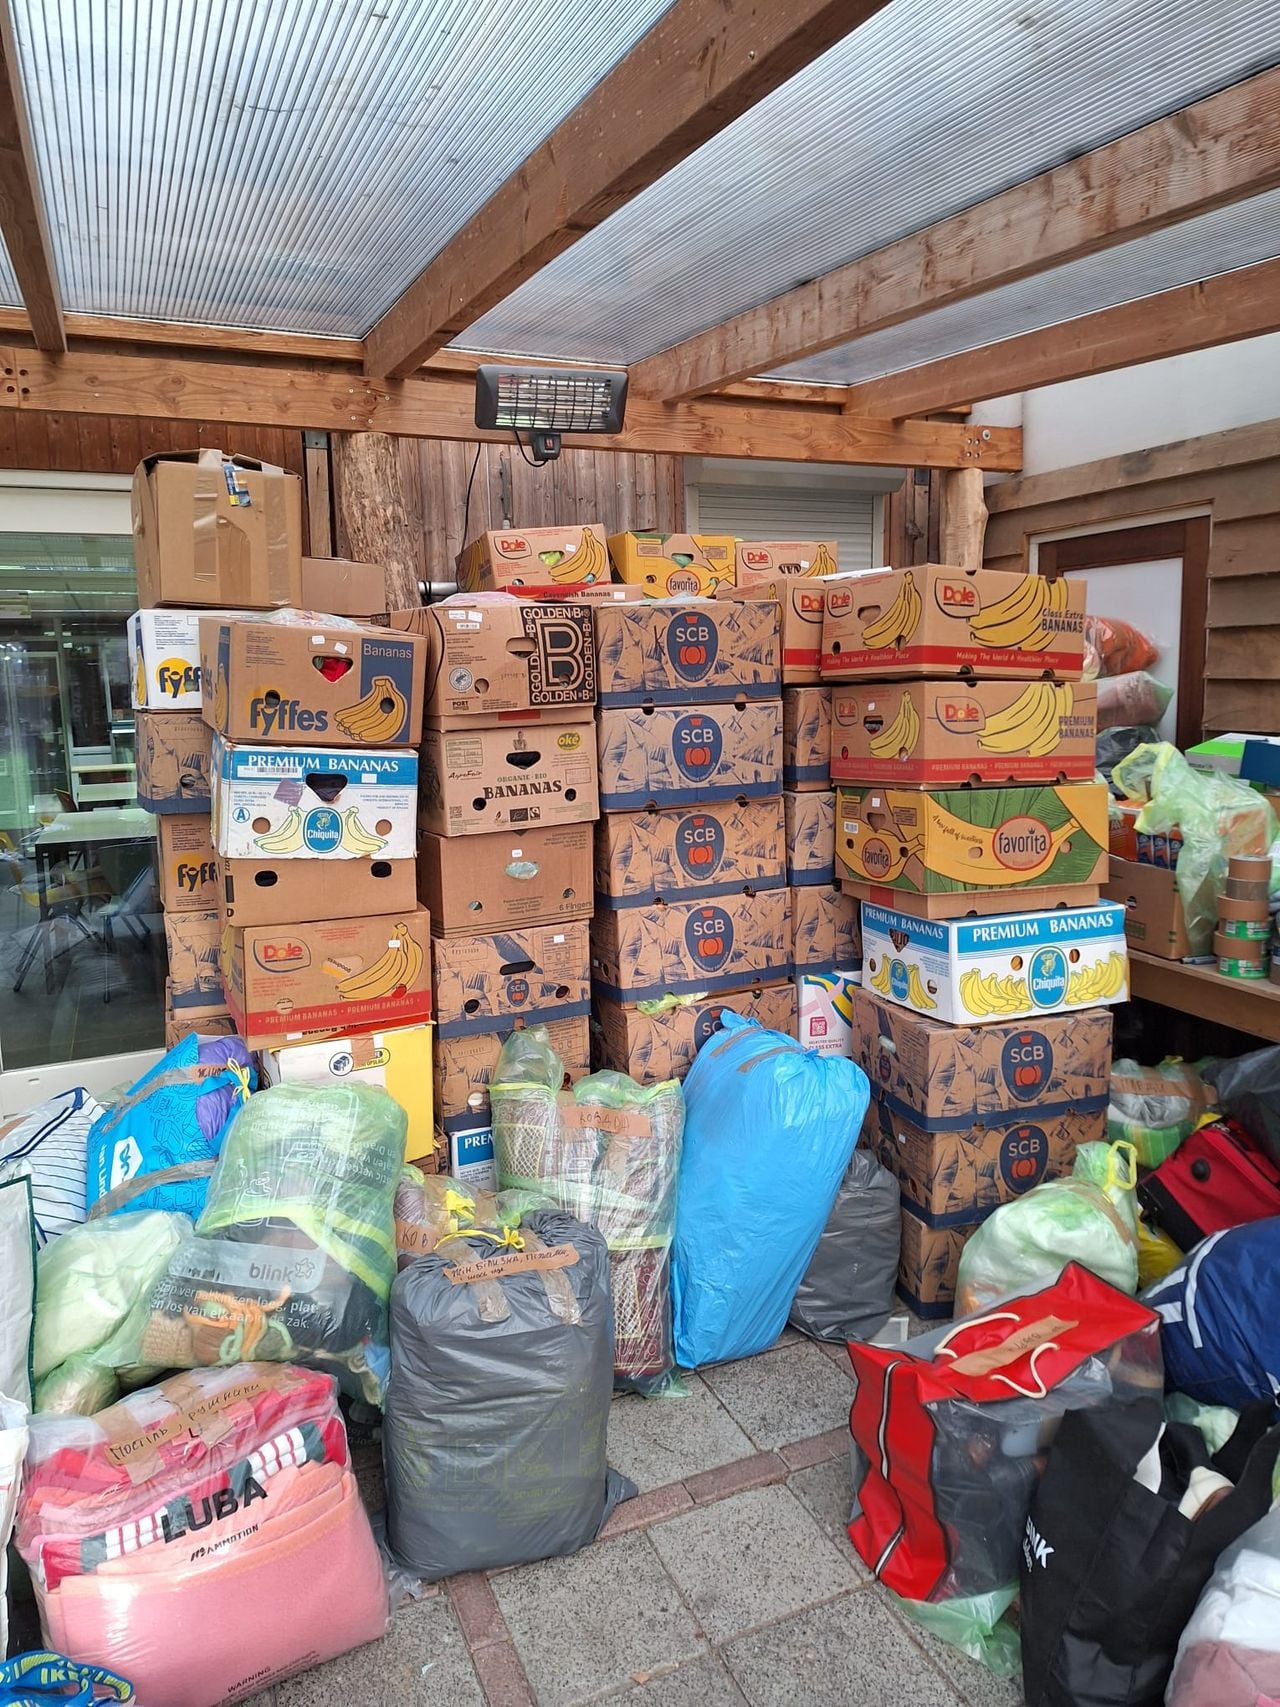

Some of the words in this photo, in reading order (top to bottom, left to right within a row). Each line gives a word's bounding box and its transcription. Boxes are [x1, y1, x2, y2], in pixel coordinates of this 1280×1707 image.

[501, 539, 526, 549] Dole
[747, 552, 768, 561] Dole
[669, 577, 698, 592] favorita
[801, 594, 824, 610] Dol
[831, 592, 850, 606] Dole
[943, 585, 975, 603] Dole
[523, 607, 571, 619] GOLDEN
[1042, 607, 1062, 618] Class
[1065, 609, 1083, 620] Extra
[1042, 619, 1083, 633] BANANAS
[676, 627, 709, 643] SCB
[363, 643, 412, 658] Bananas
[583, 637, 594, 690] GOLDEN
[159, 666, 201, 699] fyff
[531, 690, 577, 703] GOLDEN
[839, 702, 856, 714] Dole
[945, 704, 979, 720] Dole
[250, 697, 329, 736] fyffes
[1059, 716, 1095, 726] PREMIUM
[558, 732, 580, 746] oké
[681, 728, 714, 744] SCB
[1059, 728, 1095, 739] BANANAS
[248, 755, 320, 769] PREMIUM
[328, 758, 399, 772] BANANAS
[483, 780, 562, 800] BANANAS
[236, 808, 246, 822] A
[307, 829, 339, 841] Chiquita
[683, 828, 716, 844] SCB
[998, 832, 1047, 855] favorita
[864, 847, 889, 868] favorita
[177, 861, 218, 892] fyff
[693, 919, 725, 936] SCB
[865, 907, 896, 926] PREMIUM
[901, 918, 944, 940] BANANAS
[973, 922, 1040, 943] PREMIUM
[1050, 913, 1113, 934] BANANAS
[263, 943, 303, 960] Dole
[1033, 976, 1065, 992] Chiquita
[265, 1014, 300, 1024] PREMIUM
[302, 1009, 338, 1021] BANANAS
[347, 1004, 380, 1014] PREMIUM
[382, 999, 414, 1010] BANANAS
[702, 1020, 722, 1035] SC
[1010, 1045, 1045, 1063] SCB
[1008, 1138, 1041, 1157] SCB
[250, 1263, 294, 1283] blink
[151, 1299, 164, 1309] en
[166, 1299, 183, 1313] los
[186, 1305, 207, 1317] van
[210, 1307, 252, 1323] elkaar
[286, 1316, 310, 1329] zak.
[290, 1301, 317, 1314] plat
[160, 1476, 268, 1544] LUBA
[228, 1666, 271, 1693] WARNING
